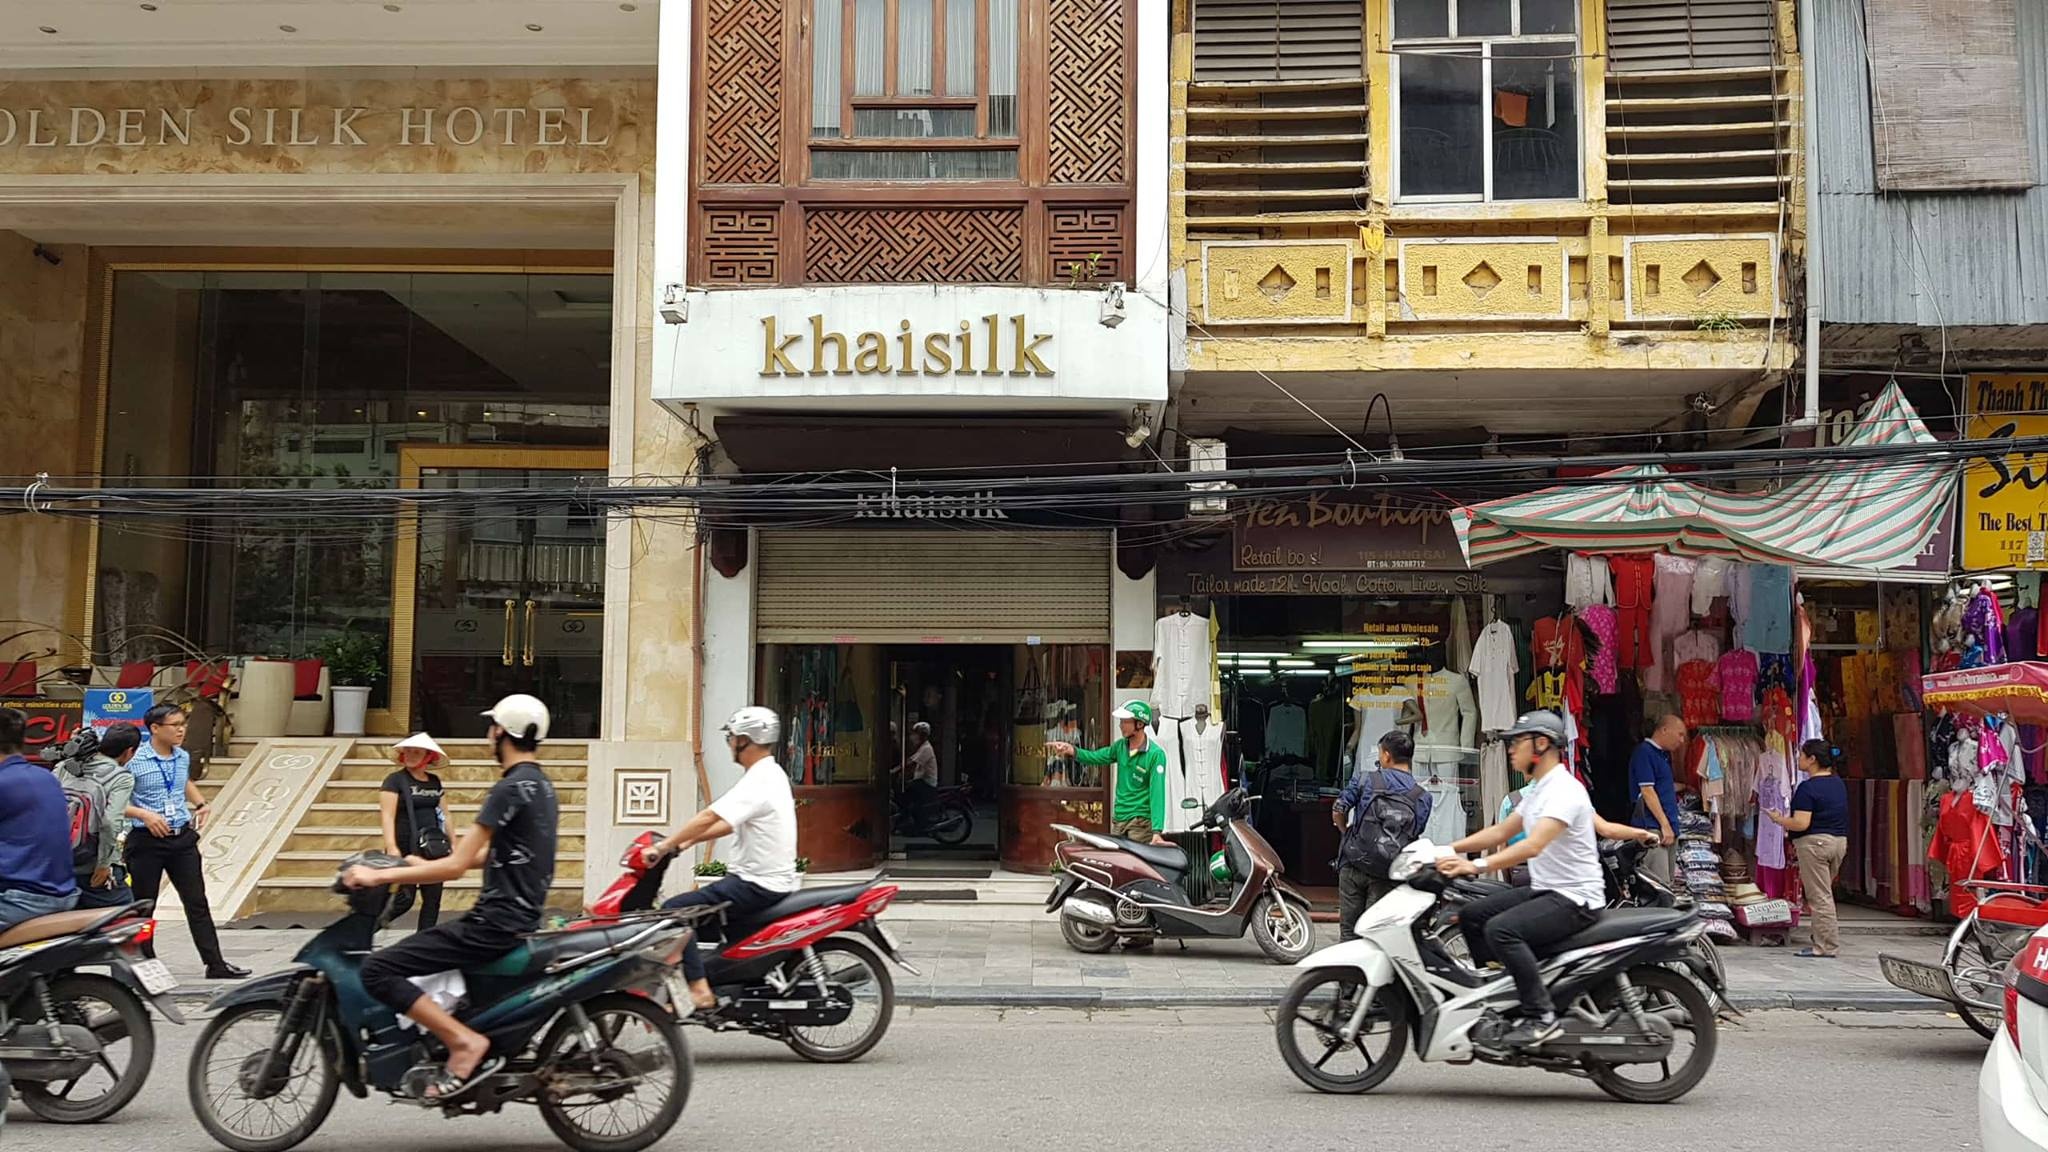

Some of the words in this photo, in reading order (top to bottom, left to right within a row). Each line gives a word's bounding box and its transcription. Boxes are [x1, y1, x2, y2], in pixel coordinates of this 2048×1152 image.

[226, 106, 367, 146] SILK
[400, 106, 610, 146] HOTEL
[759, 313, 1055, 377] khaisilk
[1977, 380, 2025, 411] Thanh
[1979, 422, 2048, 498] Si
[1306, 485, 1451, 545] Boutiqu
[1978, 512, 2002, 531] The
[2006, 512, 2032, 531] Best
[1240, 544, 1282, 567] Retail
[2000, 540, 2024, 551] 117
[1187, 572, 1230, 594] Tailor
[1234, 573, 1266, 594] made
[1455, 573, 1489, 593] Silk
[1363, 623, 1385, 633] Retail
[1386, 623, 1400, 633] and
